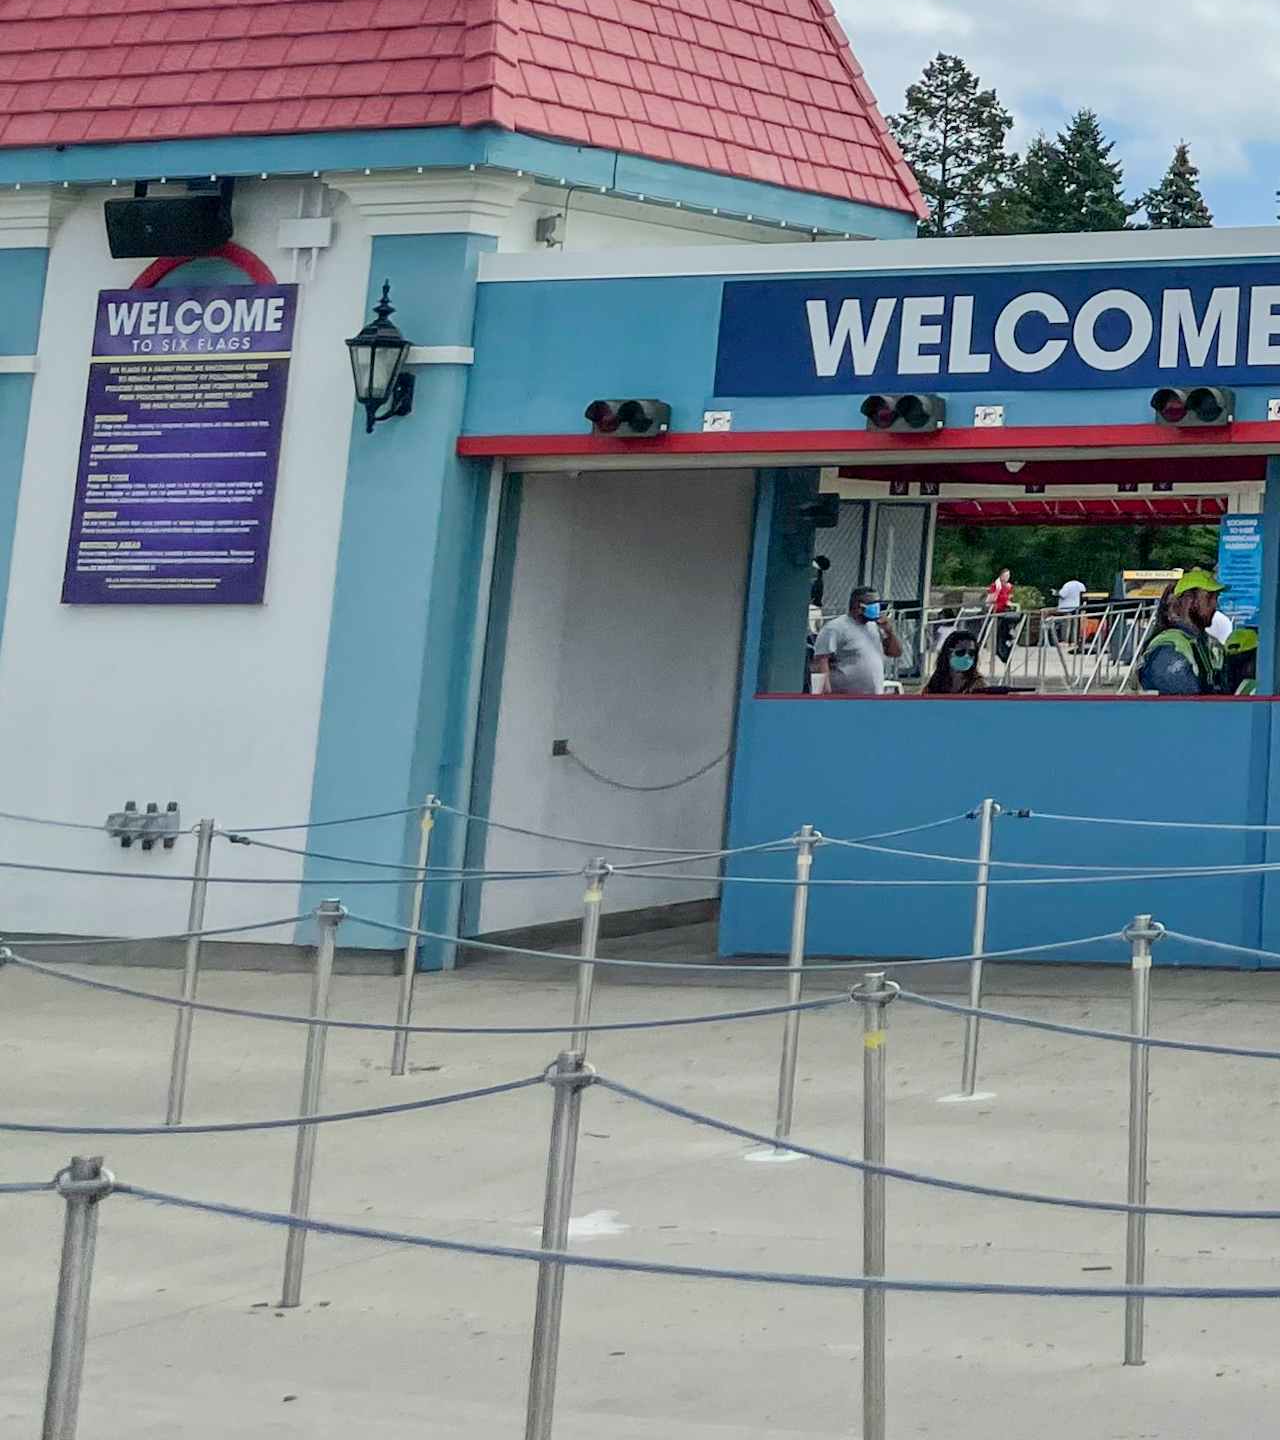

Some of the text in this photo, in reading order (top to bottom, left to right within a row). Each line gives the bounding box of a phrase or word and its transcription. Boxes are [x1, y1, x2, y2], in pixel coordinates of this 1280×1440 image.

[107, 297, 285, 336] WELCOME
[132, 337, 251, 352] TO SIX FLAGS
